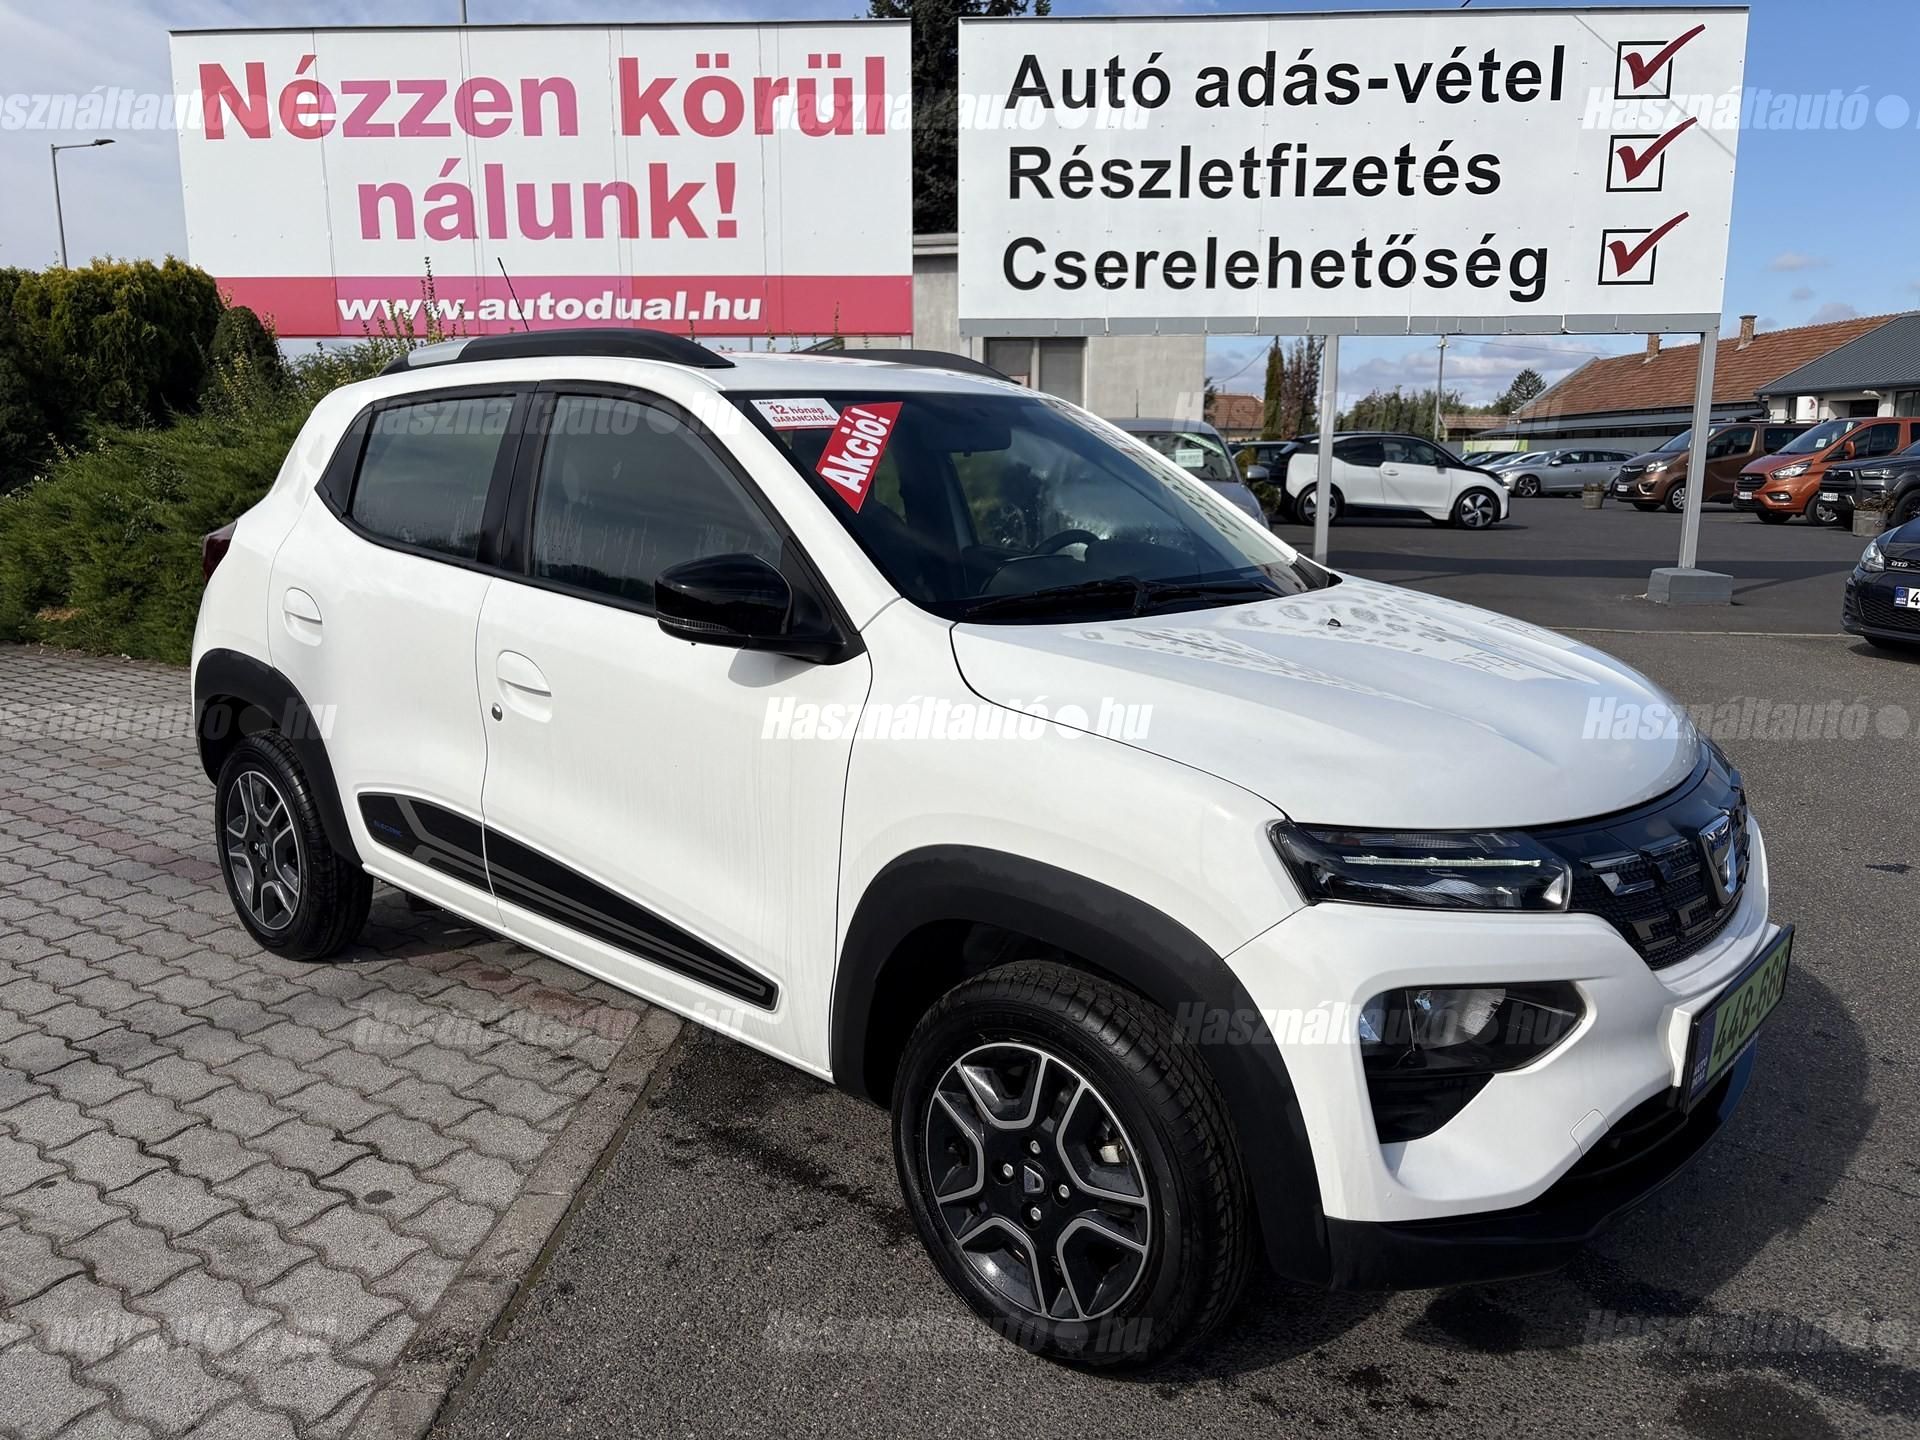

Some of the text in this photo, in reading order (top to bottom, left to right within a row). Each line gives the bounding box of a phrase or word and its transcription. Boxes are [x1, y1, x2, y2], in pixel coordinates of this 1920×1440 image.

[200, 53, 886, 140] Nézzen körül
[1005, 45, 1565, 109] Autó adás-vétel
[359, 158, 739, 241] nálunk!
[1009, 139, 1502, 199] Részletfizetés
[1003, 232, 1549, 303] Cserelehetőség
[337, 290, 762, 321] www.autodual.hu
[769, 405, 825, 415] 12 hónap
[821, 407, 892, 494] Akció!
